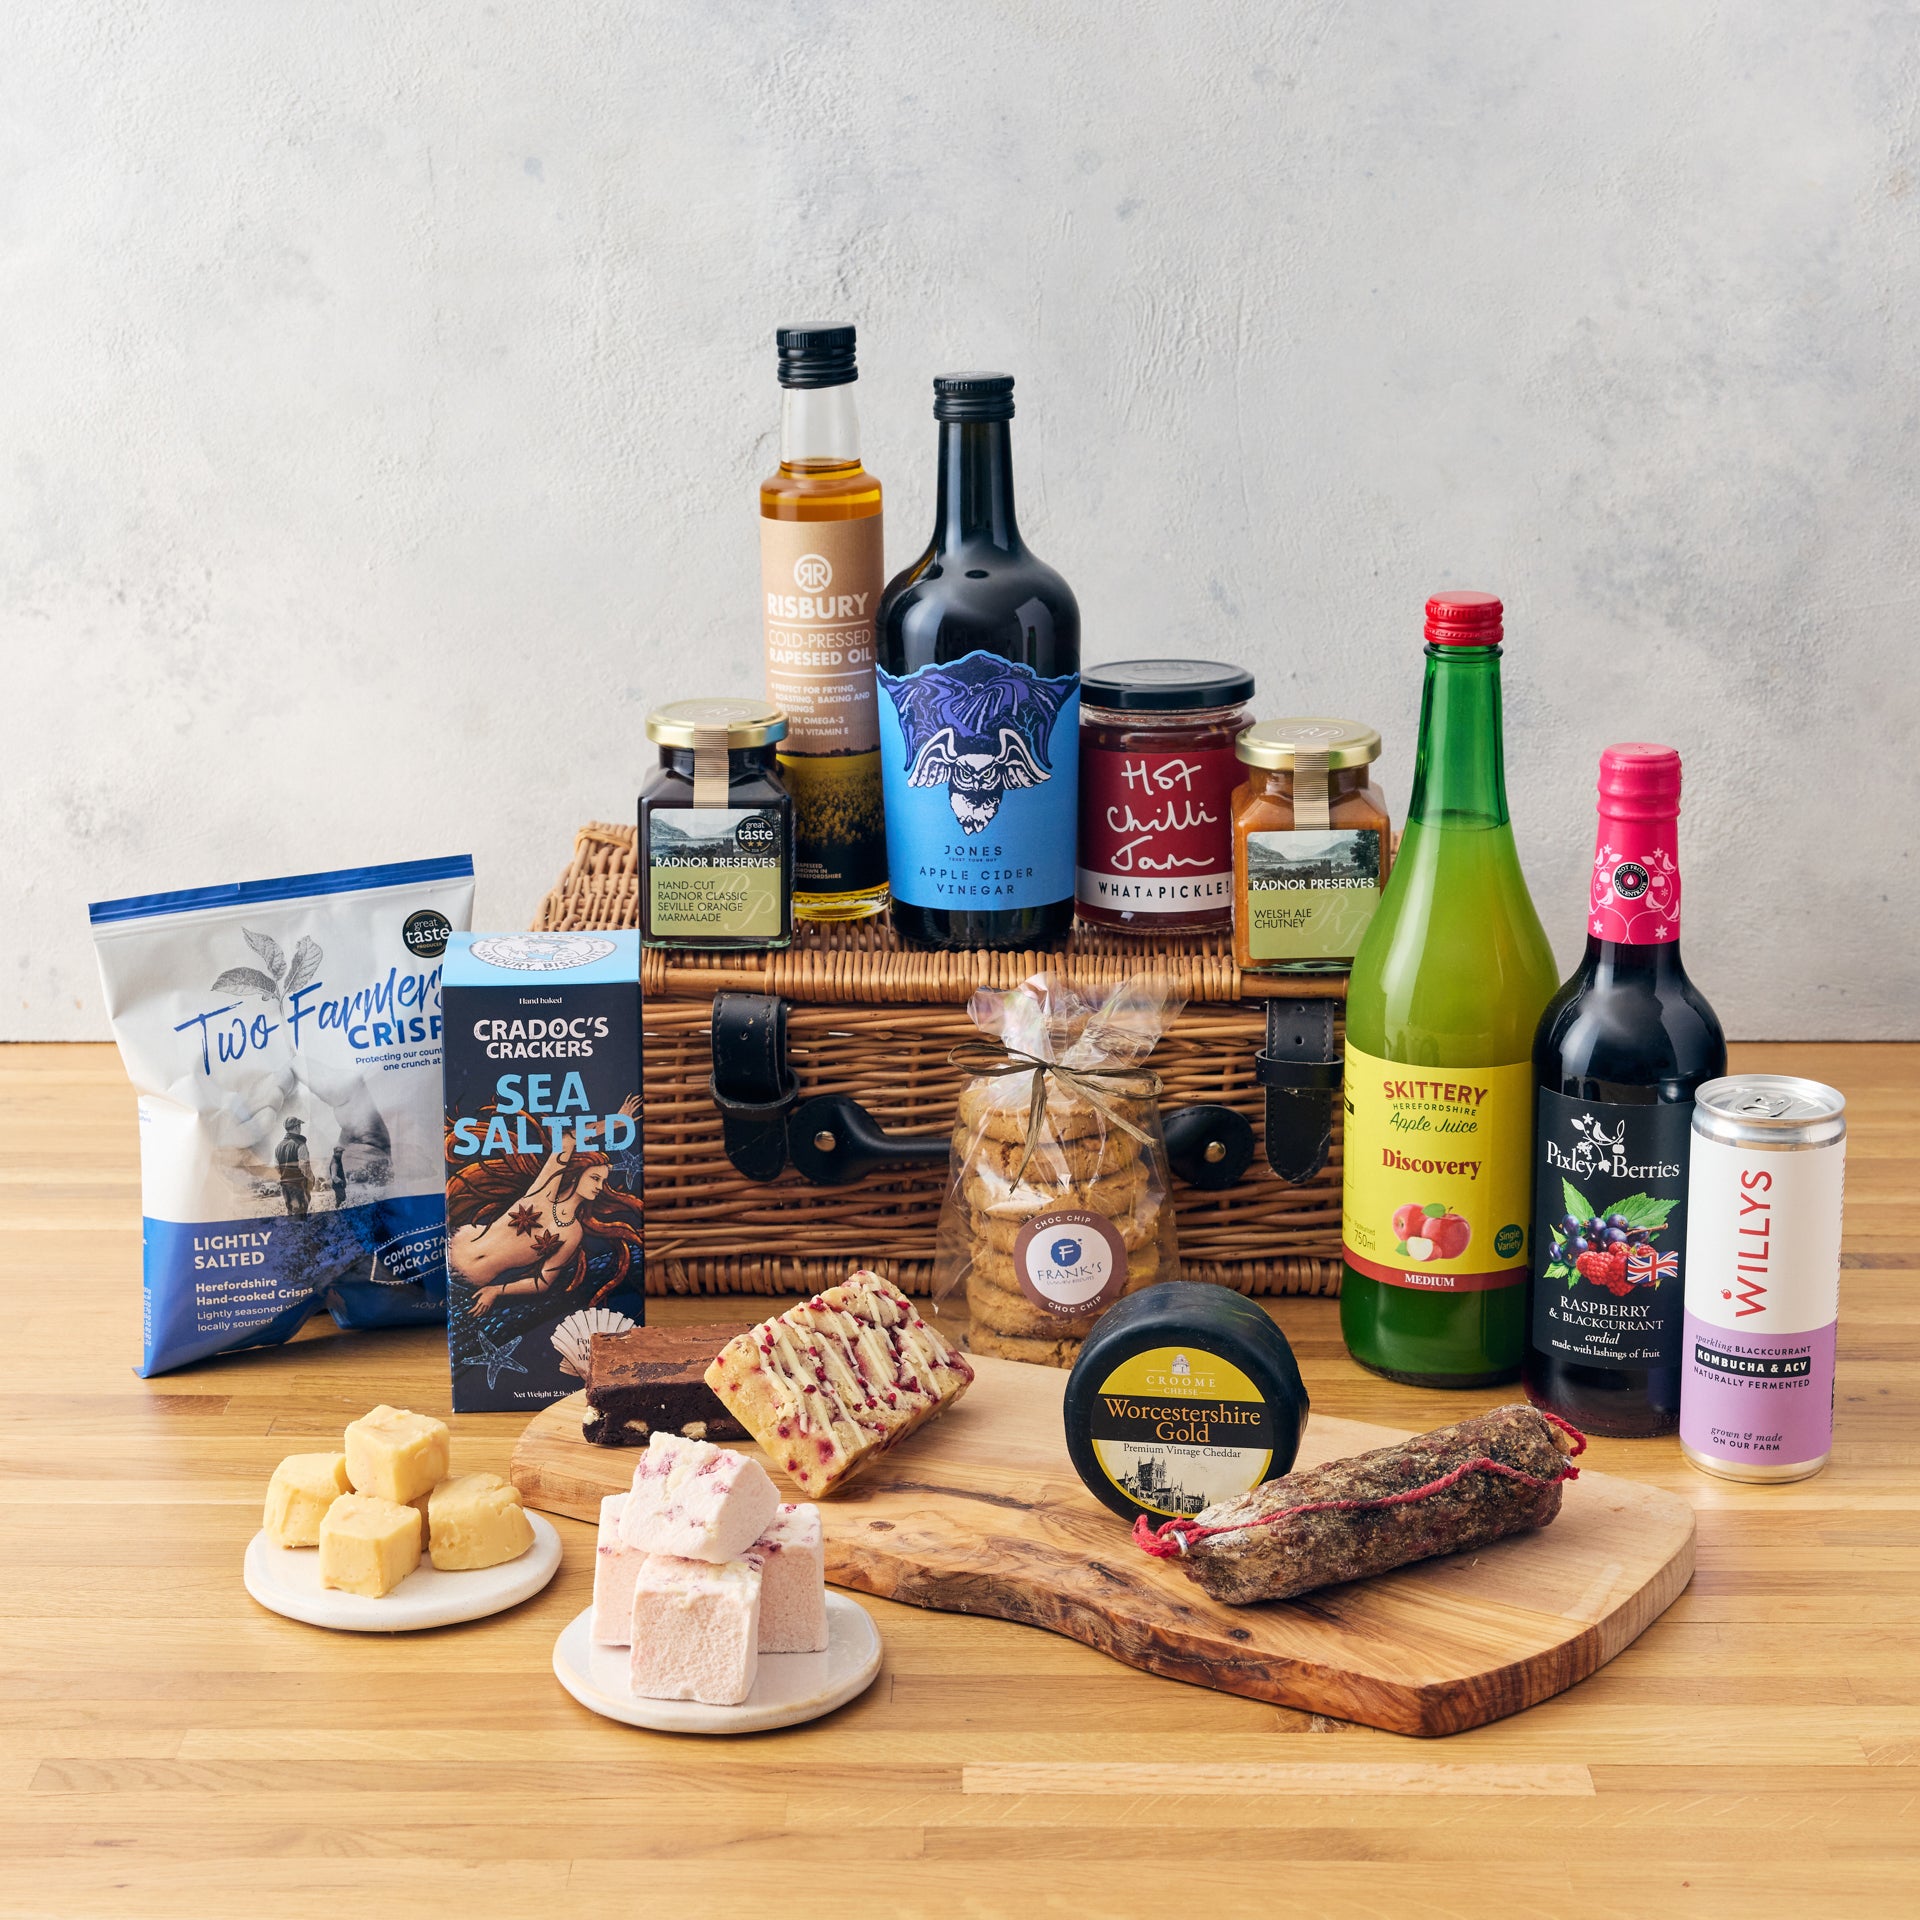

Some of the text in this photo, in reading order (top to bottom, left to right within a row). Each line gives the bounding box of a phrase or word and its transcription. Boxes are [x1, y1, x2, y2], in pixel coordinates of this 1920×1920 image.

[767, 592, 869, 620] RISBURY
[768, 629, 871, 649] COLD-PRESSED
[769, 647, 872, 666] RAPESEED OIL
[803, 686, 820, 694] FOR
[818, 693, 851, 704] BAKING
[854, 691, 870, 701] AND
[803, 716, 844, 725] OMEGA-3
[806, 728, 842, 736] VITAMIN
[844, 727, 849, 735] E
[1107, 800, 1218, 833] Chilli
[737, 829, 774, 840] taste
[745, 822, 765, 831] great
[944, 845, 1002, 856] JONES
[1111, 835, 1215, 871] Jam
[655, 857, 776, 868] RADNOR PRESERVES
[920, 866, 1033, 880] APPLE CIDER
[657, 881, 715, 890] HAND-CUT
[937, 883, 1015, 895] VINEGAR
[1252, 877, 1375, 891] RADNOR PRESERVES
[657, 891, 748, 901] RADNOR CLASSIC
[657, 902, 743, 911] SEVILLE ORANGE
[1254, 908, 1312, 919] WELSH ALE
[414, 918, 438, 931] great
[657, 913, 722, 922] MARMALADE
[1254, 918, 1305, 929] CHUTNEY
[405, 927, 450, 944] taste
[543, 950, 606, 969] BISCUITS
[473, 1017, 609, 1041] CRADOC'S
[174, 1001, 279, 1076] Two
[486, 1040, 593, 1059] CRACKERS
[355, 1052, 401, 1064] Protecting
[401, 1058, 431, 1068] crunch
[432, 1057, 441, 1065] at
[496, 1071, 591, 1114] SEA
[1383, 1081, 1488, 1106] SKITTERY
[1393, 1103, 1477, 1116] HEREFORDSHIRE
[1389, 1111, 1478, 1134] Apple Juice
[453, 1113, 636, 1156] SALTED
[1381, 1148, 1482, 1180] Discovery
[1547, 1141, 1680, 1181] Pixley Berries
[1035, 1215, 1091, 1230] CHOC CHIP
[193, 1231, 272, 1251] LIGHTLY
[1354, 1229, 1376, 1251] 750ml
[1499, 1229, 1520, 1241] Single
[1736, 1169, 1773, 1318] WILLYS
[194, 1251, 265, 1270] SALTED
[1037, 1261, 1102, 1281] FRANK'S
[195, 1278, 278, 1293] Herefordshire
[1405, 1273, 1455, 1287] MEDIUM
[196, 1287, 314, 1306] Hand-cooked Crisps
[1048, 1295, 1102, 1313] CHOC CHIP
[197, 1309, 233, 1321] Lightly
[234, 1304, 283, 1317] seasoned
[1560, 1295, 1650, 1317] RASPBERRY
[197, 1316, 273, 1332] locally sourced
[1549, 1307, 1664, 1331] & BLACKCURRANT
[1585, 1332, 1620, 1344] cordial
[1695, 1334, 1811, 1356] sparkling BLACKCURRANT
[1552, 1339, 1661, 1360] made with lashings of fruit
[1697, 1349, 1807, 1373] KOMBUCHA & ACV
[1146, 1375, 1216, 1388] CROOME
[1693, 1366, 1810, 1390] NATURALLY FERMENTED
[527, 1390, 552, 1399] Weight
[1163, 1387, 1199, 1396] CHEESE
[1104, 1398, 1261, 1426] Worcestershire
[1155, 1421, 1211, 1443] Gold
[1711, 1427, 1740, 1439] grown
[1755, 1433, 1783, 1442] made
[1123, 1443, 1242, 1458] Premium Vintage Cheddar
[1712, 1436, 1780, 1451] ON OUR FARM
